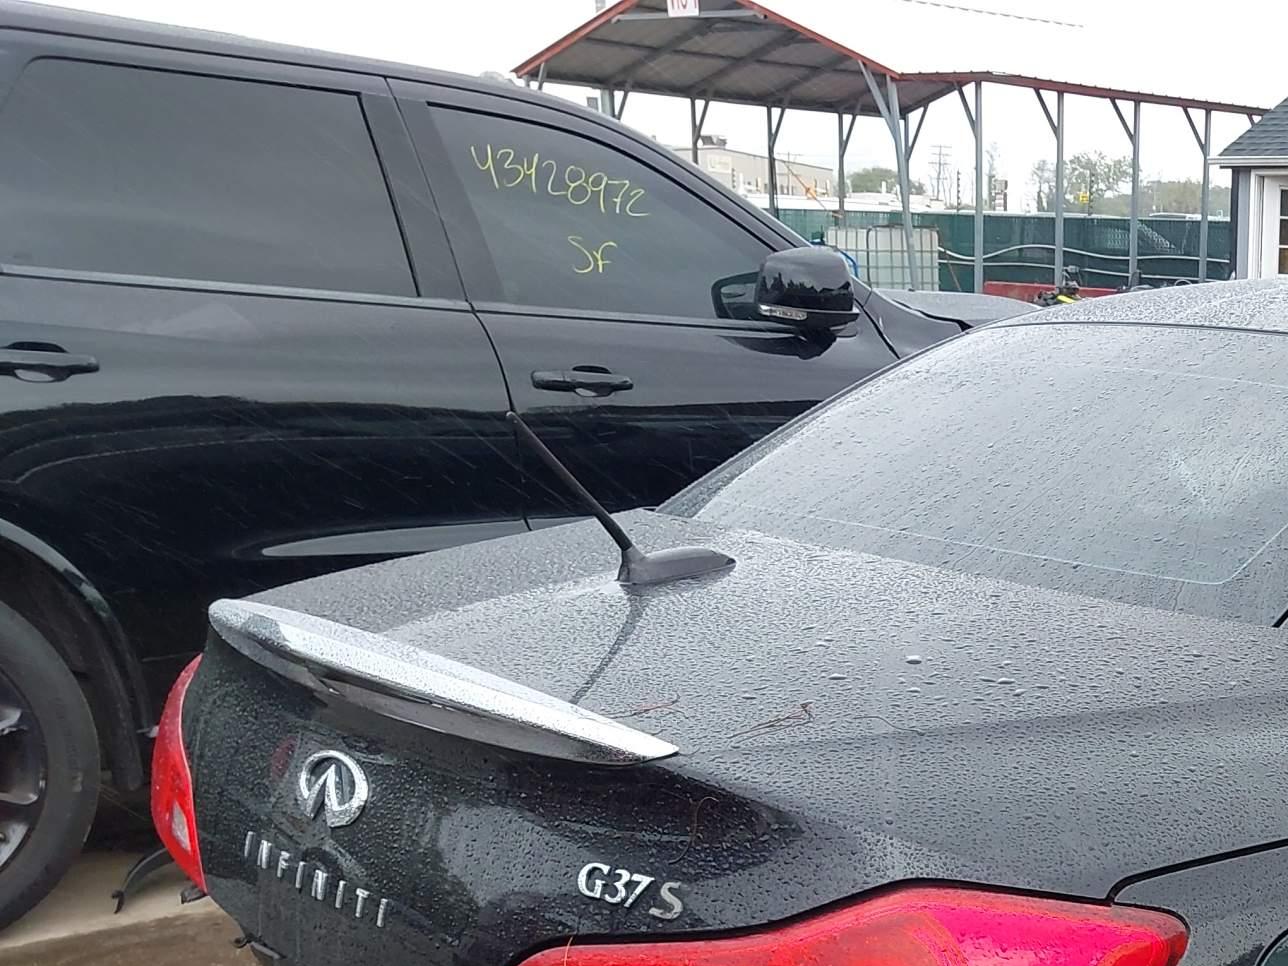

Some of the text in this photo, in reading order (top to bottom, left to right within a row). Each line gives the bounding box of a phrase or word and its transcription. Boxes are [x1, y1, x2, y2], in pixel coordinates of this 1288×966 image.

[470, 143, 650, 217] 43428972
[244, 831, 389, 928] INFINITI
[577, 862, 684, 920] G37 S
